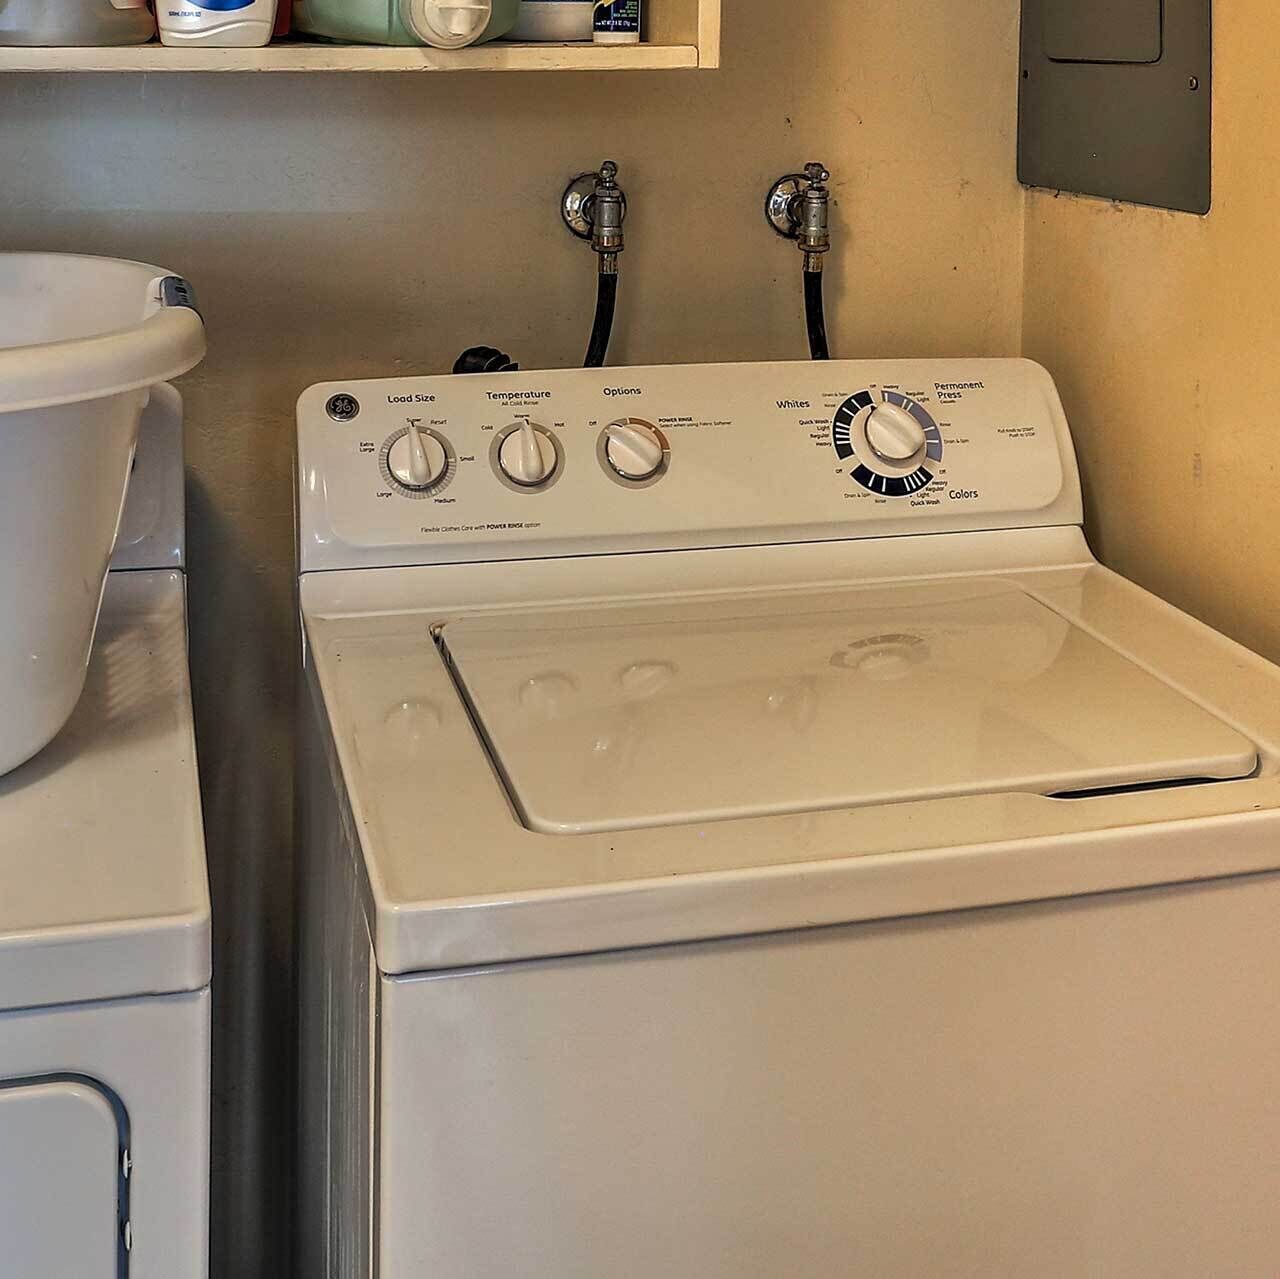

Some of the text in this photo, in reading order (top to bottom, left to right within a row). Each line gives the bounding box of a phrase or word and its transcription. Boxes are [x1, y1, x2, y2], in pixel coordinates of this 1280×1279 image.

[934, 381, 985, 391] Permanent
[486, 390, 551, 400] Temperature
[603, 386, 642, 397] Options
[937, 391, 962, 399] Press
[387, 393, 436, 404] Load Size
[776, 399, 810, 409] Whites
[949, 489, 979, 500] Colors
